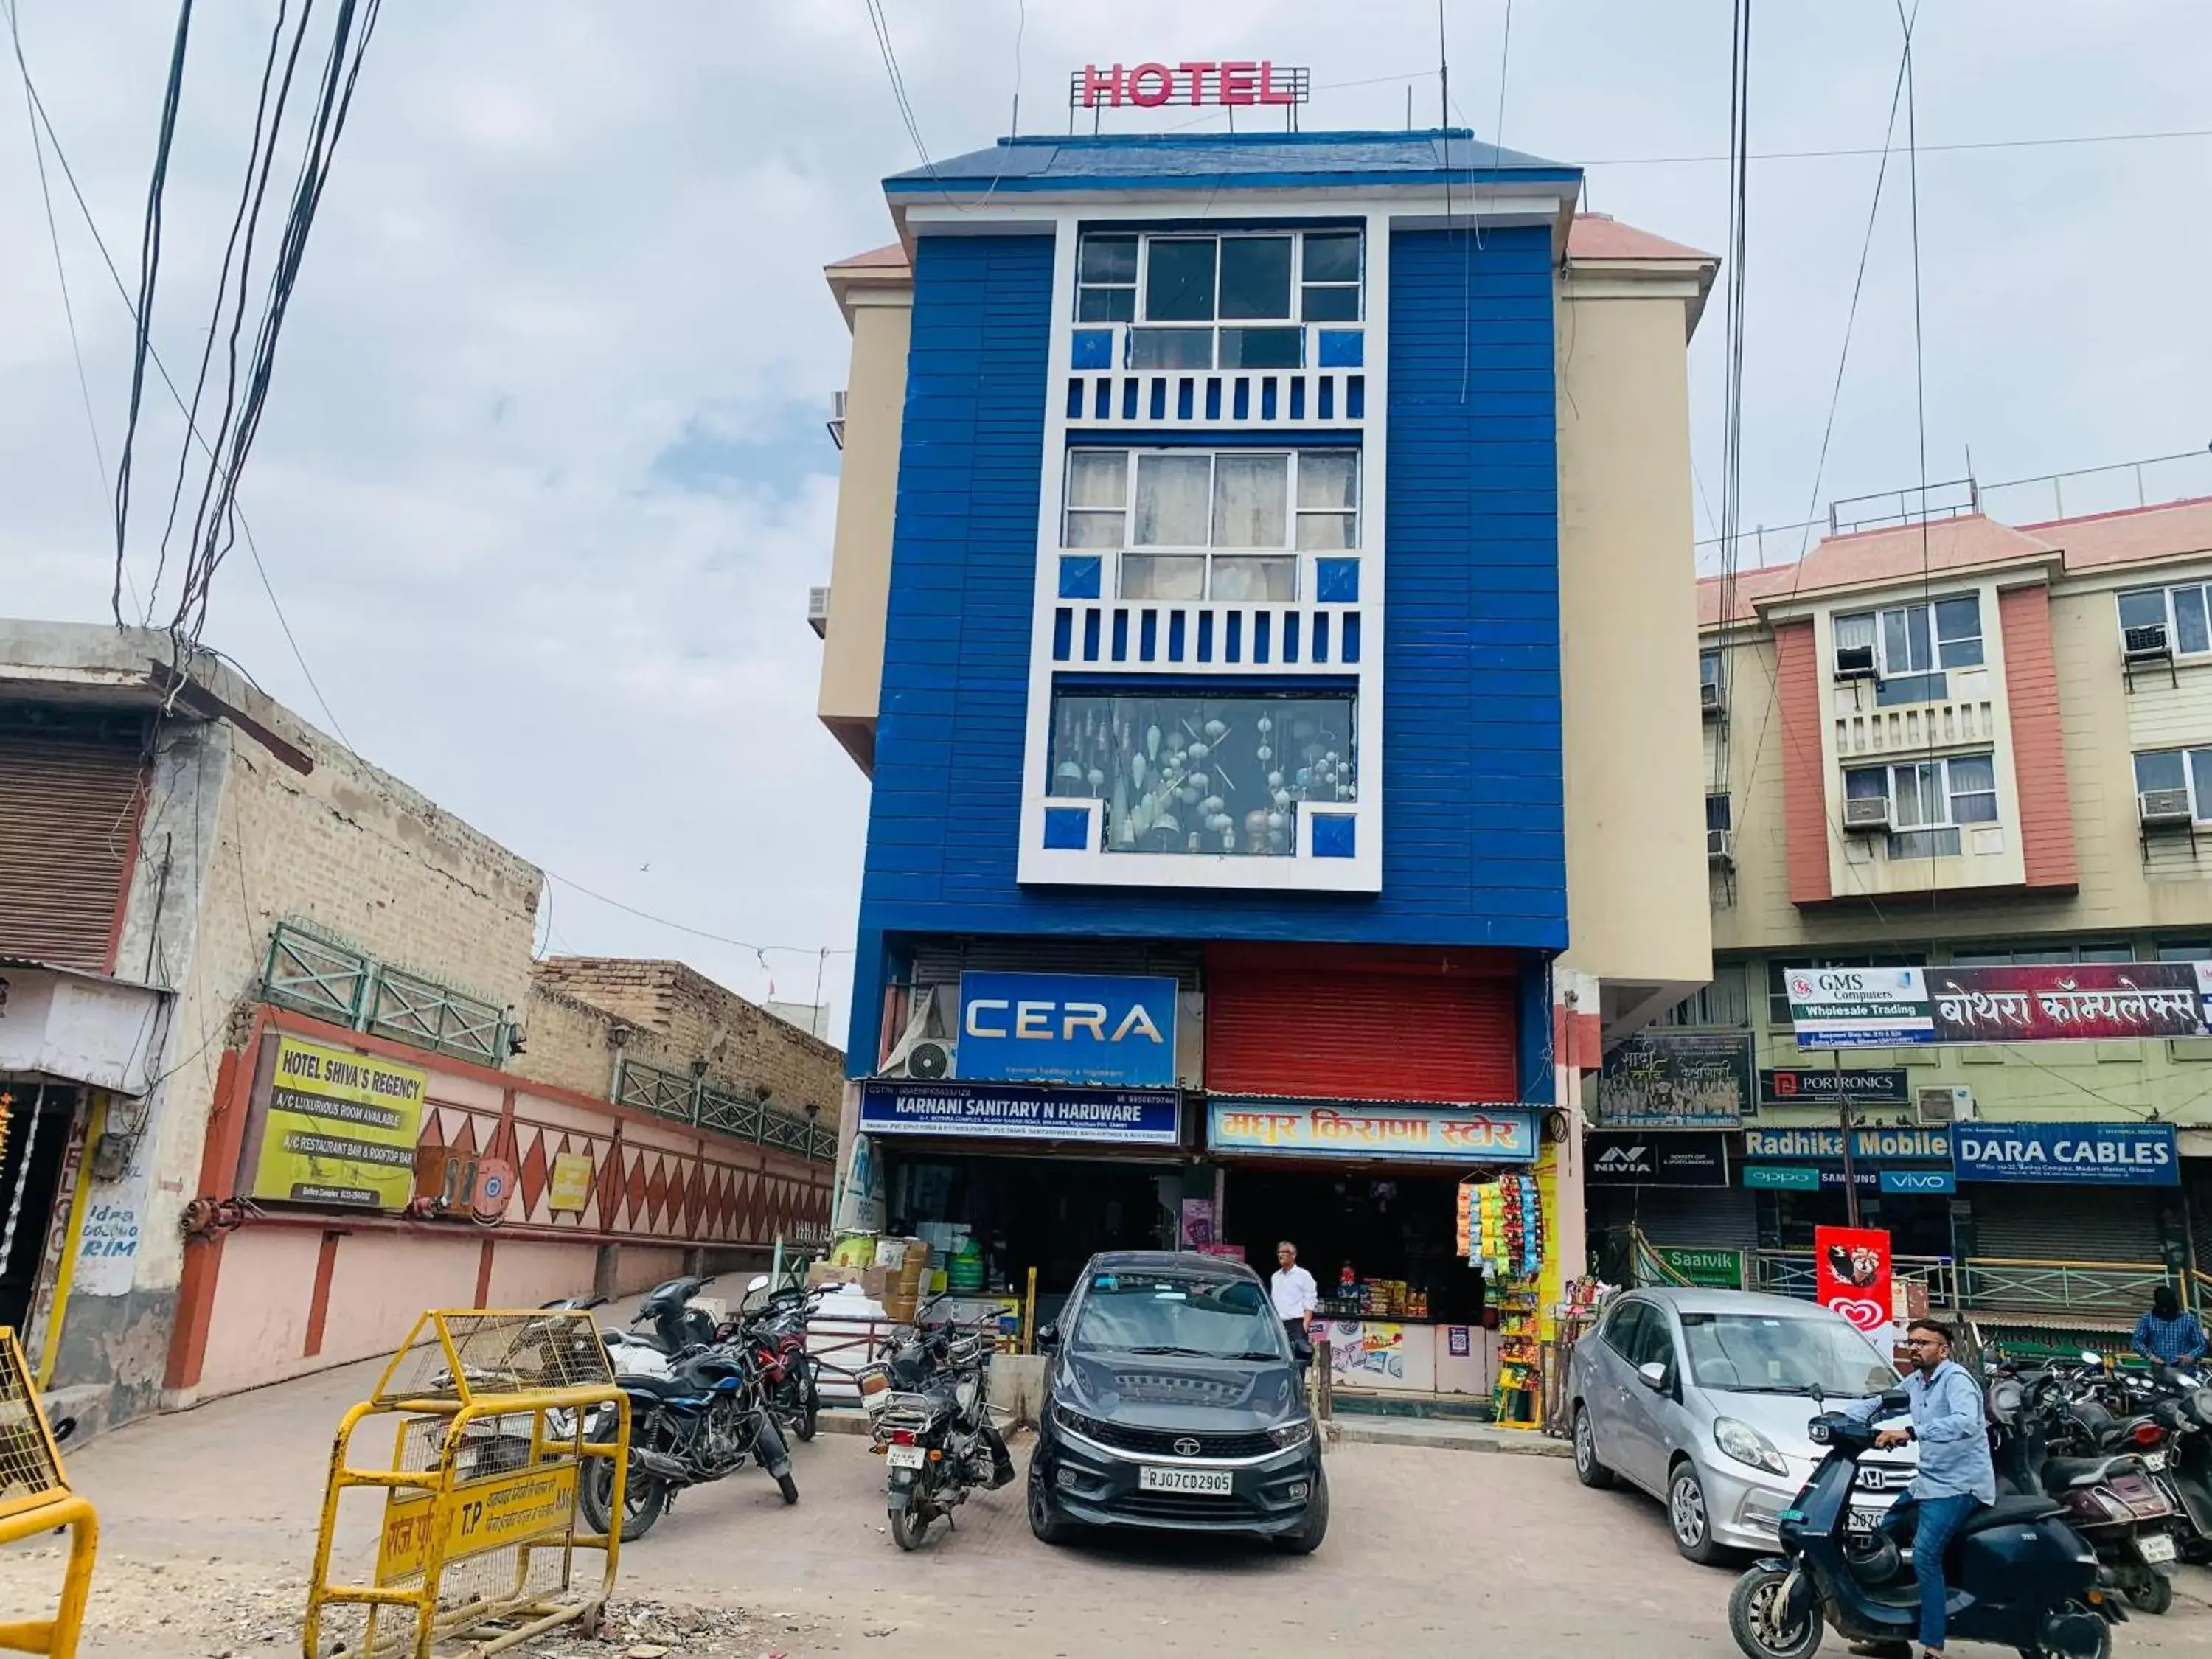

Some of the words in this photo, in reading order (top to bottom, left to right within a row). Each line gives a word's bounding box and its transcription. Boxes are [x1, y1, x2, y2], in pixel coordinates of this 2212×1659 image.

[1083, 61, 1294, 108] HOTEL
[1818, 973, 1863, 990] GMS
[1834, 990, 1893, 1001] Computers
[1934, 981, 2031, 1026] बोथरा
[1806, 1006, 1868, 1015] Wholesale
[1871, 1004, 1916, 1016] Trading
[966, 999, 1164, 1043] CERA
[282, 1049, 321, 1079] HOTEL
[324, 1060, 370, 1089] SHIVA'S
[372, 1070, 421, 1100] REGENCY
[1803, 1076, 1893, 1090] PORTRONICS
[276, 1093, 294, 1108] A/C
[295, 1096, 340, 1116] LUXURIOUS
[340, 1105, 363, 1120] ROOM
[363, 1110, 401, 1127] AVAILABLE
[896, 1096, 962, 1114] KARNANI
[965, 1099, 1040, 1118] SANITARY
[1043, 1103, 1055, 1119] N
[1058, 1103, 1141, 1121] HARDWARE
[1220, 1112, 1302, 1144] मधुर
[1310, 1107, 1431, 1142] किराणा
[1439, 1114, 1520, 1148] स्टोर
[283, 1135, 301, 1151] A/C
[301, 1138, 347, 1155] RESTAURANT
[347, 1144, 362, 1156] BAR
[362, 1147, 368, 1158] &
[369, 1147, 399, 1162] ROOFTOP
[1746, 1132, 1844, 1155] Radhika
[1858, 1131, 1947, 1155] Mobile
[1961, 1140, 2047, 1162] DARA
[2053, 1141, 2168, 1164] CABLES
[1593, 1163, 1651, 1172] NIVIA
[1753, 1171, 1809, 1182] oppo
[1822, 1172, 1877, 1183] SAMUNG
[1891, 1173, 1944, 1188] vivo
[81, 1239, 138, 1256] RIM
[1672, 1251, 1732, 1267] Saatvik
[1150, 1472, 1229, 1489] RJ07CD2905
